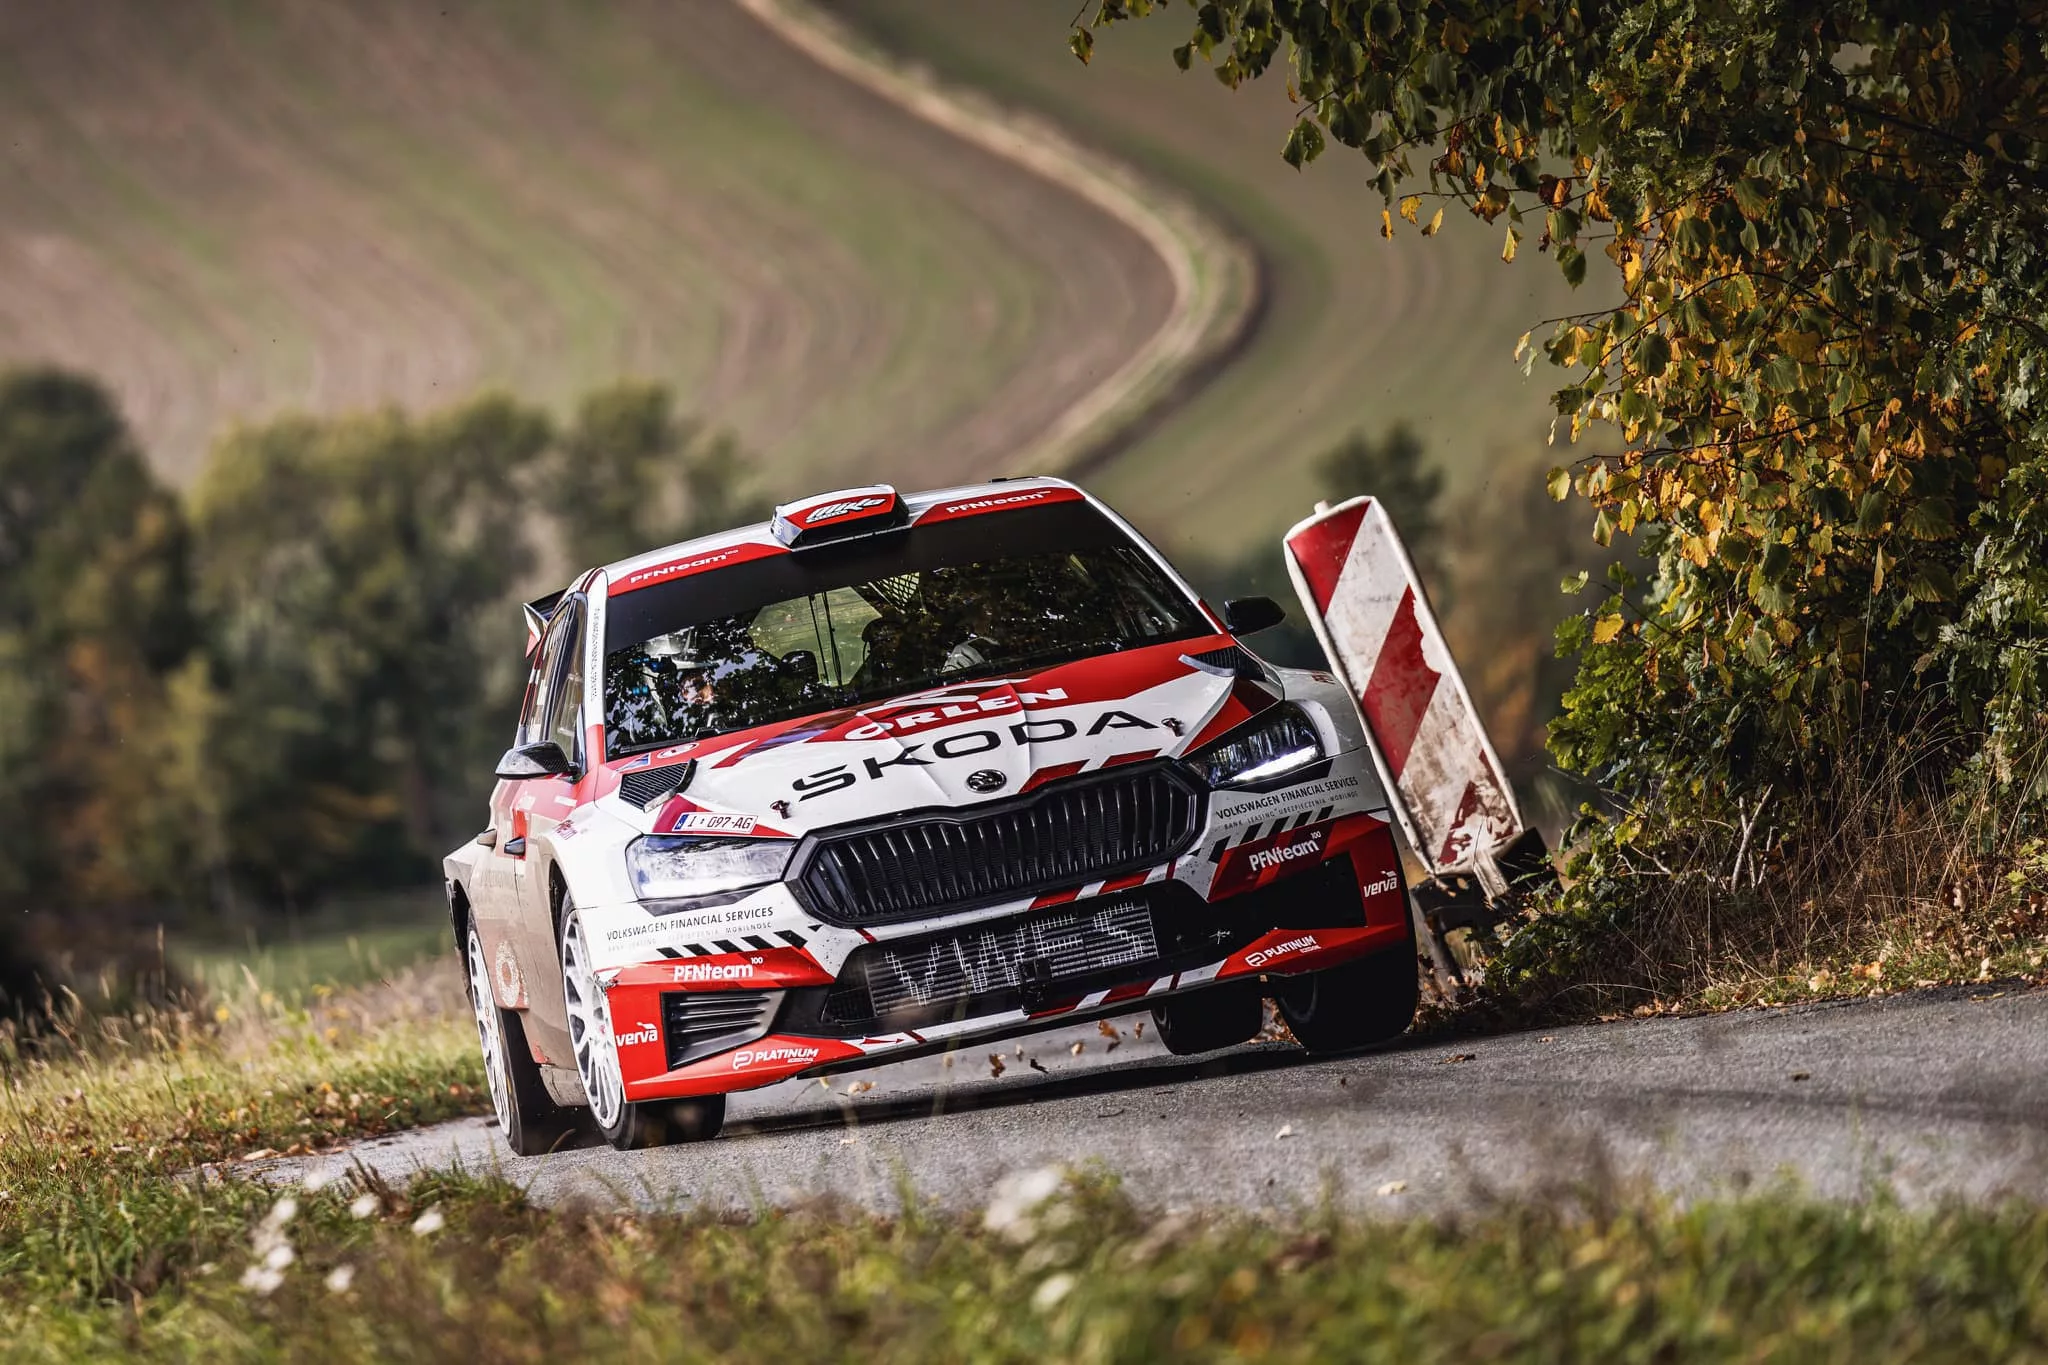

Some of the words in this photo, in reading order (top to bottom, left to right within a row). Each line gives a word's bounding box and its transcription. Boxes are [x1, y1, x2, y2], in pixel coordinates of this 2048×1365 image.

[844, 687, 1069, 741] ORLEN
[1216, 796, 1281, 820] VOLKSWAGEN
[1281, 784, 1326, 801] FINANCIAL
[1325, 776, 1359, 792] SERVICES
[1248, 839, 1320, 872] PFNteam
[1363, 876, 1398, 898] verva
[607, 922, 668, 941] VOLKSWAGEN
[670, 914, 723, 930] FINANCIAL
[726, 906, 774, 922] SERVICES
[1263, 935, 1318, 958] PLATINUM
[673, 962, 753, 982] PFNteam
[615, 1030, 658, 1047] verva
[755, 1048, 819, 1063] PLATINUM
